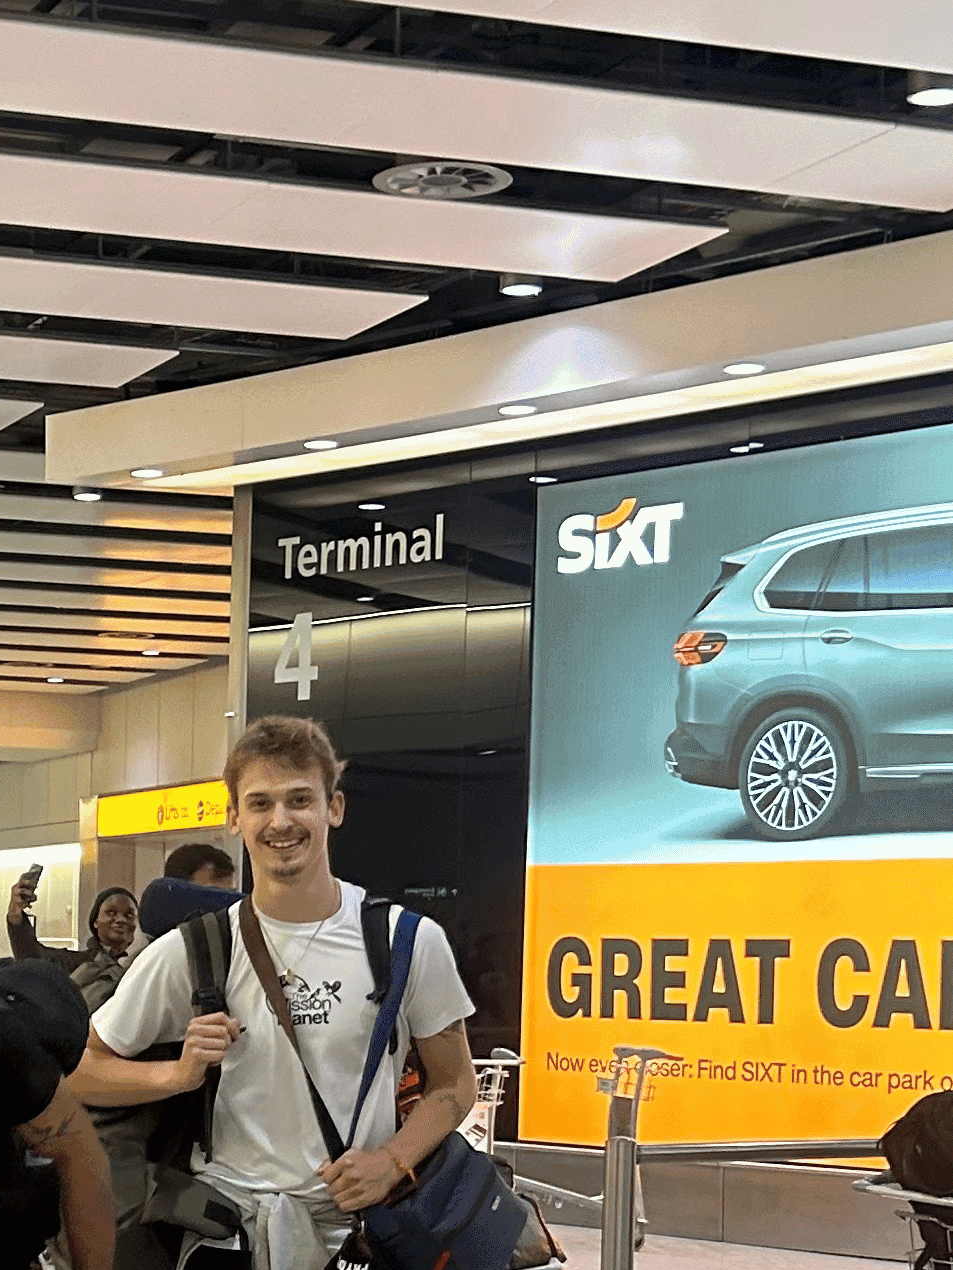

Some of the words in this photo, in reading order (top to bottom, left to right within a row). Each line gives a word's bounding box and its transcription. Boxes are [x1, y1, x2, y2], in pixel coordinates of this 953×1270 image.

[278, 514, 444, 579] Terminal
[557, 497, 684, 574] SIXT
[274, 612, 318, 700] 4
[285, 997, 332, 1011] ission
[547, 936, 791, 1025] GREAT
[546, 1051, 585, 1073] Now
[698, 1059, 736, 1081] Find
[741, 1061, 787, 1084] SIXT
[791, 1064, 807, 1084] in
[813, 1064, 845, 1086] the
[849, 1071, 882, 1088] car
[887, 1069, 934, 1094] park
